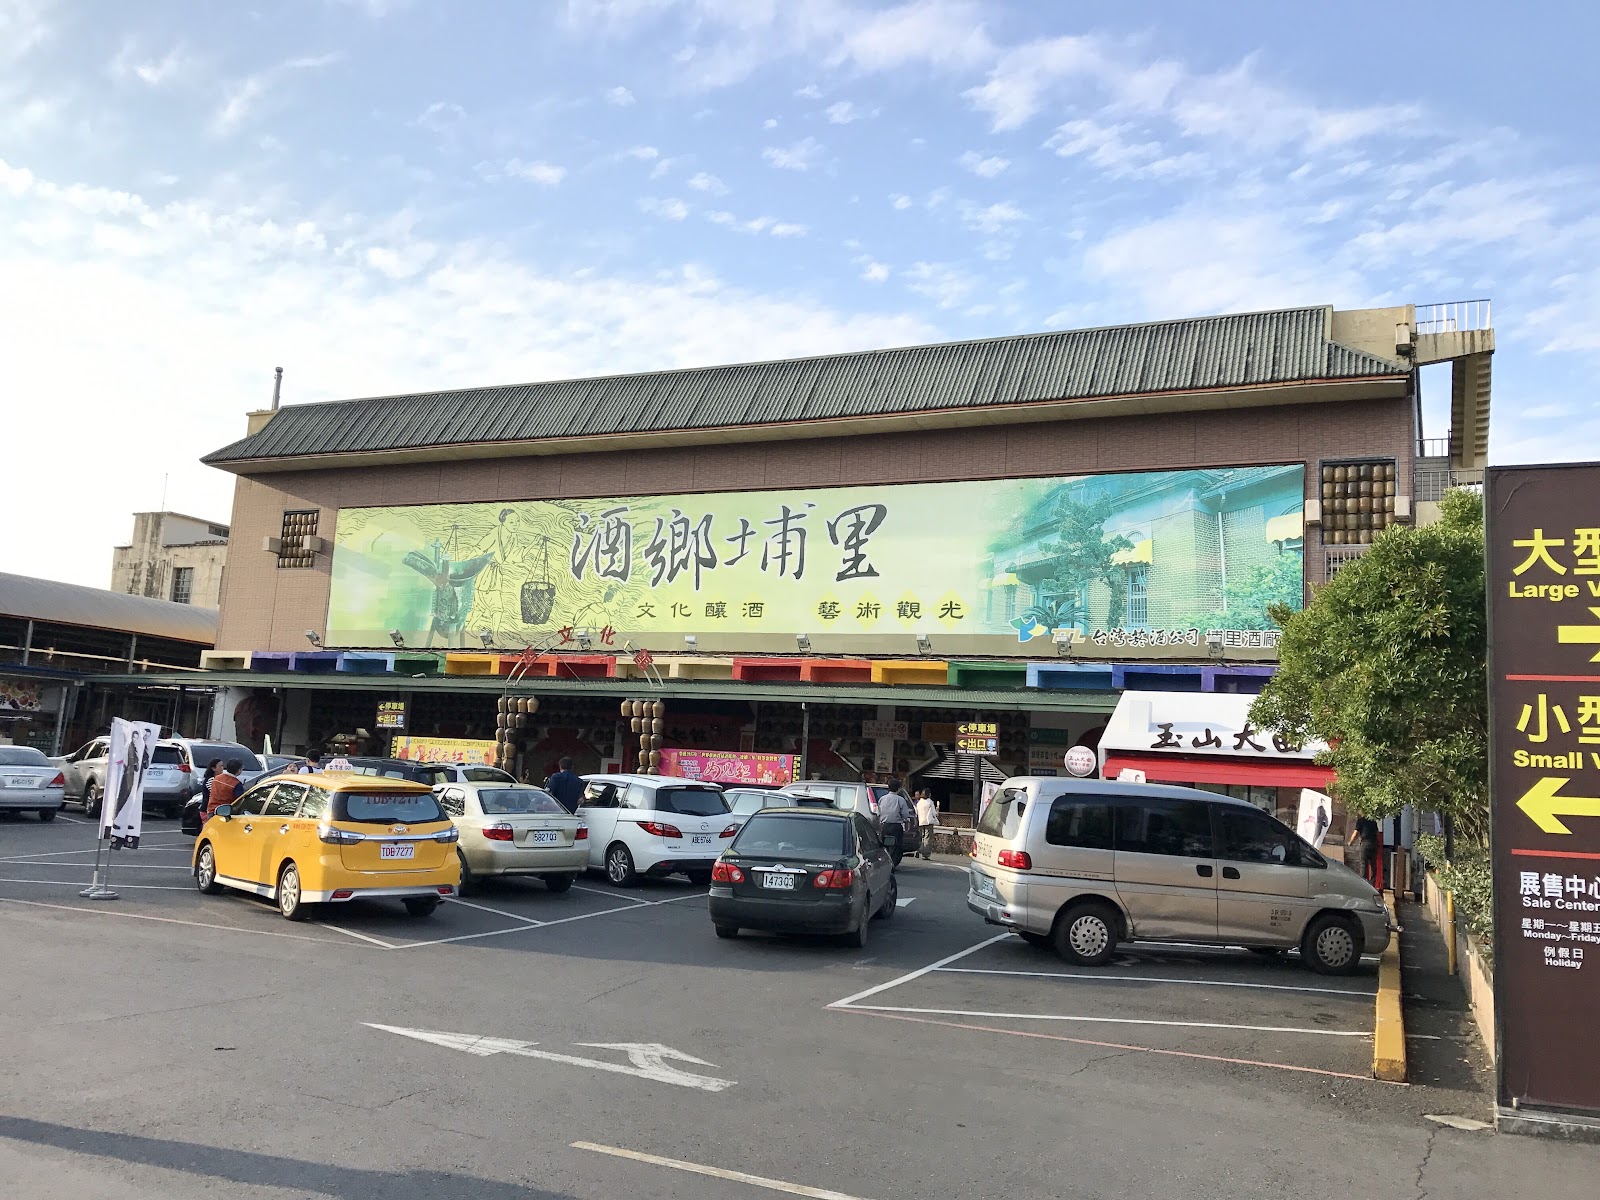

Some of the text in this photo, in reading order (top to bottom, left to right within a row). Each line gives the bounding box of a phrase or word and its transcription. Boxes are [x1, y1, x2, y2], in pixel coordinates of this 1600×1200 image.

[571, 503, 887, 591] 酒鄉埔里
[1509, 581, 1580, 602] Large
[636, 600, 965, 620] 文化釀酒 藝術觀光
[967, 723, 997, 733] 停車場
[968, 739, 986, 748] 出口
[1513, 749, 1583, 769] Small
[381, 846, 414, 857] TDB-7277
[1519, 871, 1600, 899] 展售中心
[1522, 896, 1600, 911] Sale Center
[1543, 946, 1584, 959] 例假日
[1545, 957, 1582, 970] Holiday
